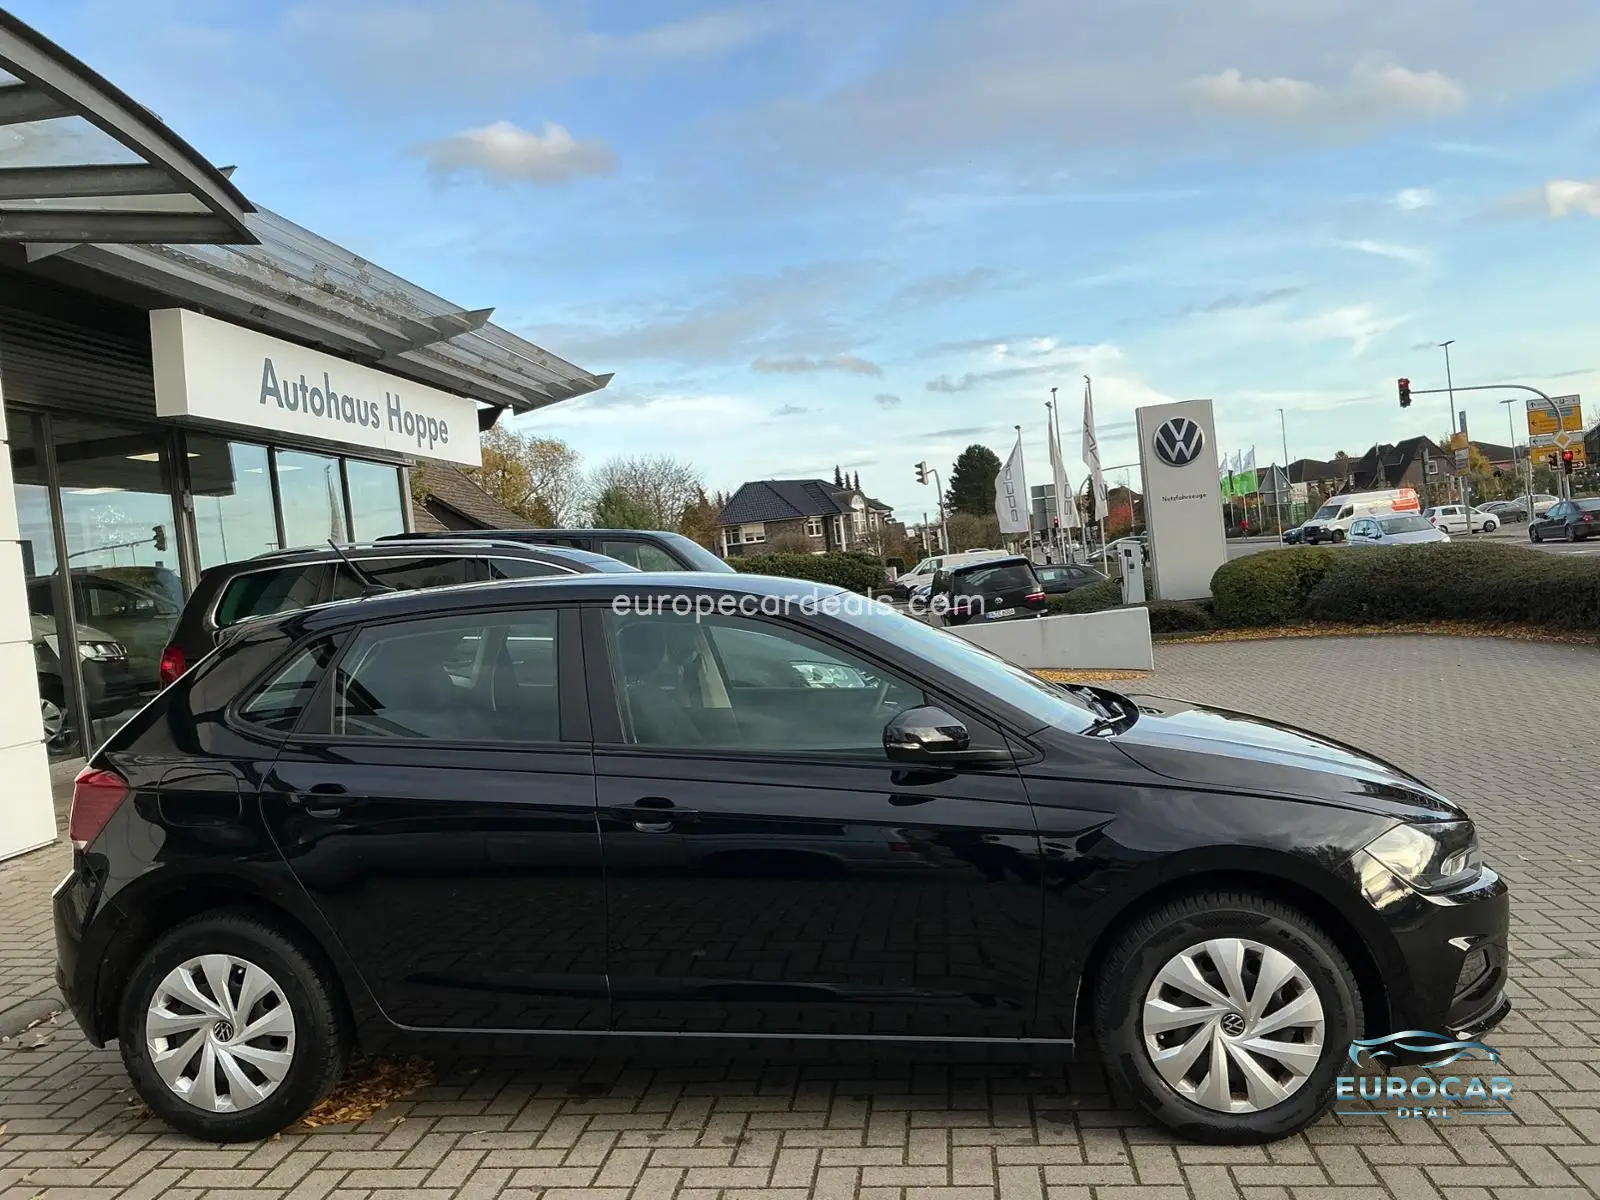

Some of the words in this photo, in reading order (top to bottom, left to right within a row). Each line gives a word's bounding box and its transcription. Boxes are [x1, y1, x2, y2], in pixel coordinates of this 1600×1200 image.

[259, 357, 380, 430] Autohaus
[385, 391, 449, 450] Hoppe
[1161, 493, 1208, 503] Nutzfahrzeuge
